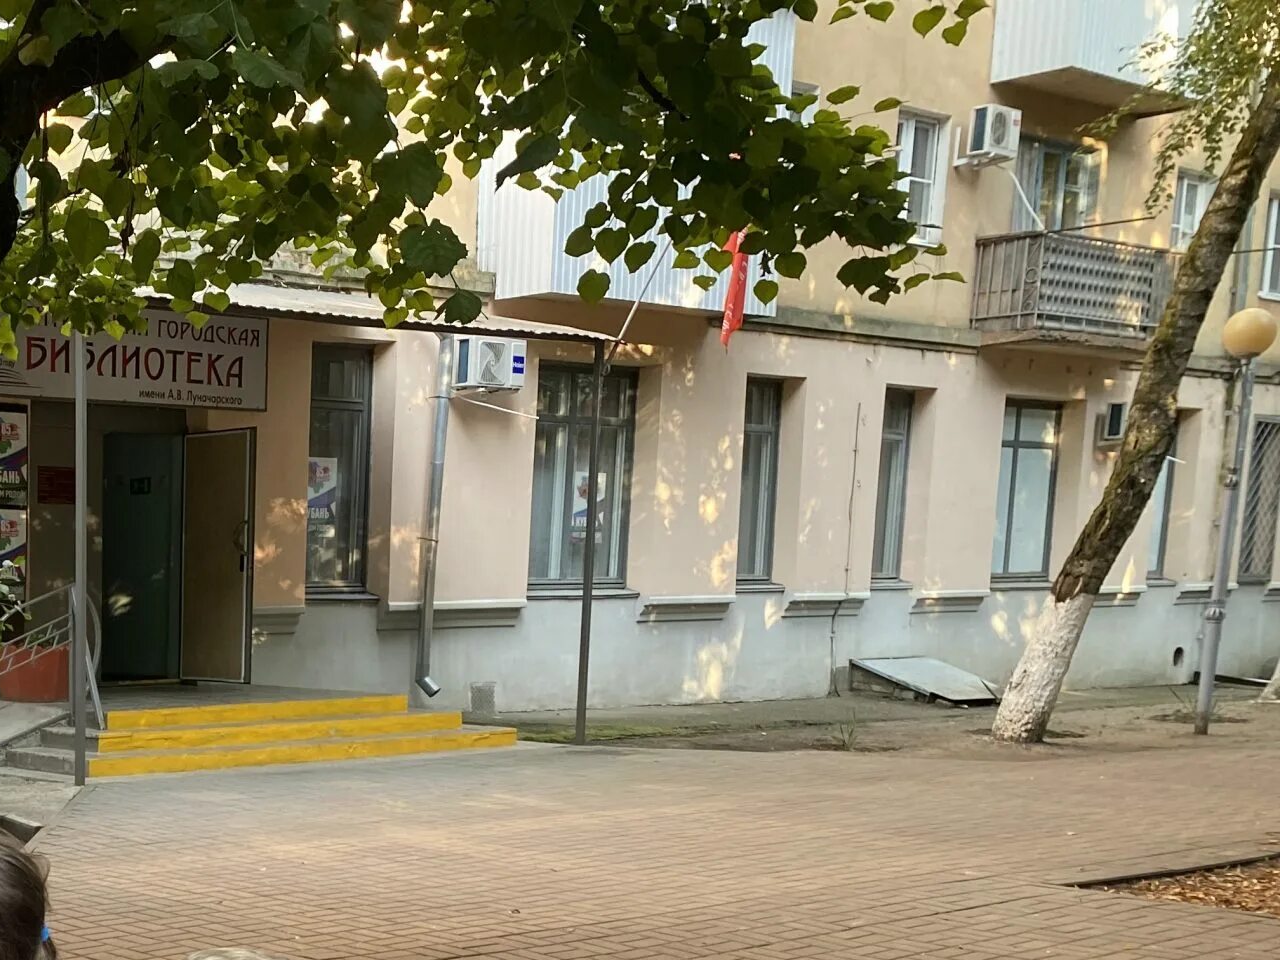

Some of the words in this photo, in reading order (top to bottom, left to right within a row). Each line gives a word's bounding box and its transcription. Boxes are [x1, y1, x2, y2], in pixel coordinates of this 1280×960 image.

[157, 319, 261, 348] ГОРОДСКАЯ
[138, 389, 166, 399] имени
[168, 389, 184, 402] А.В.
[186, 390, 243, 405] Луначарского
